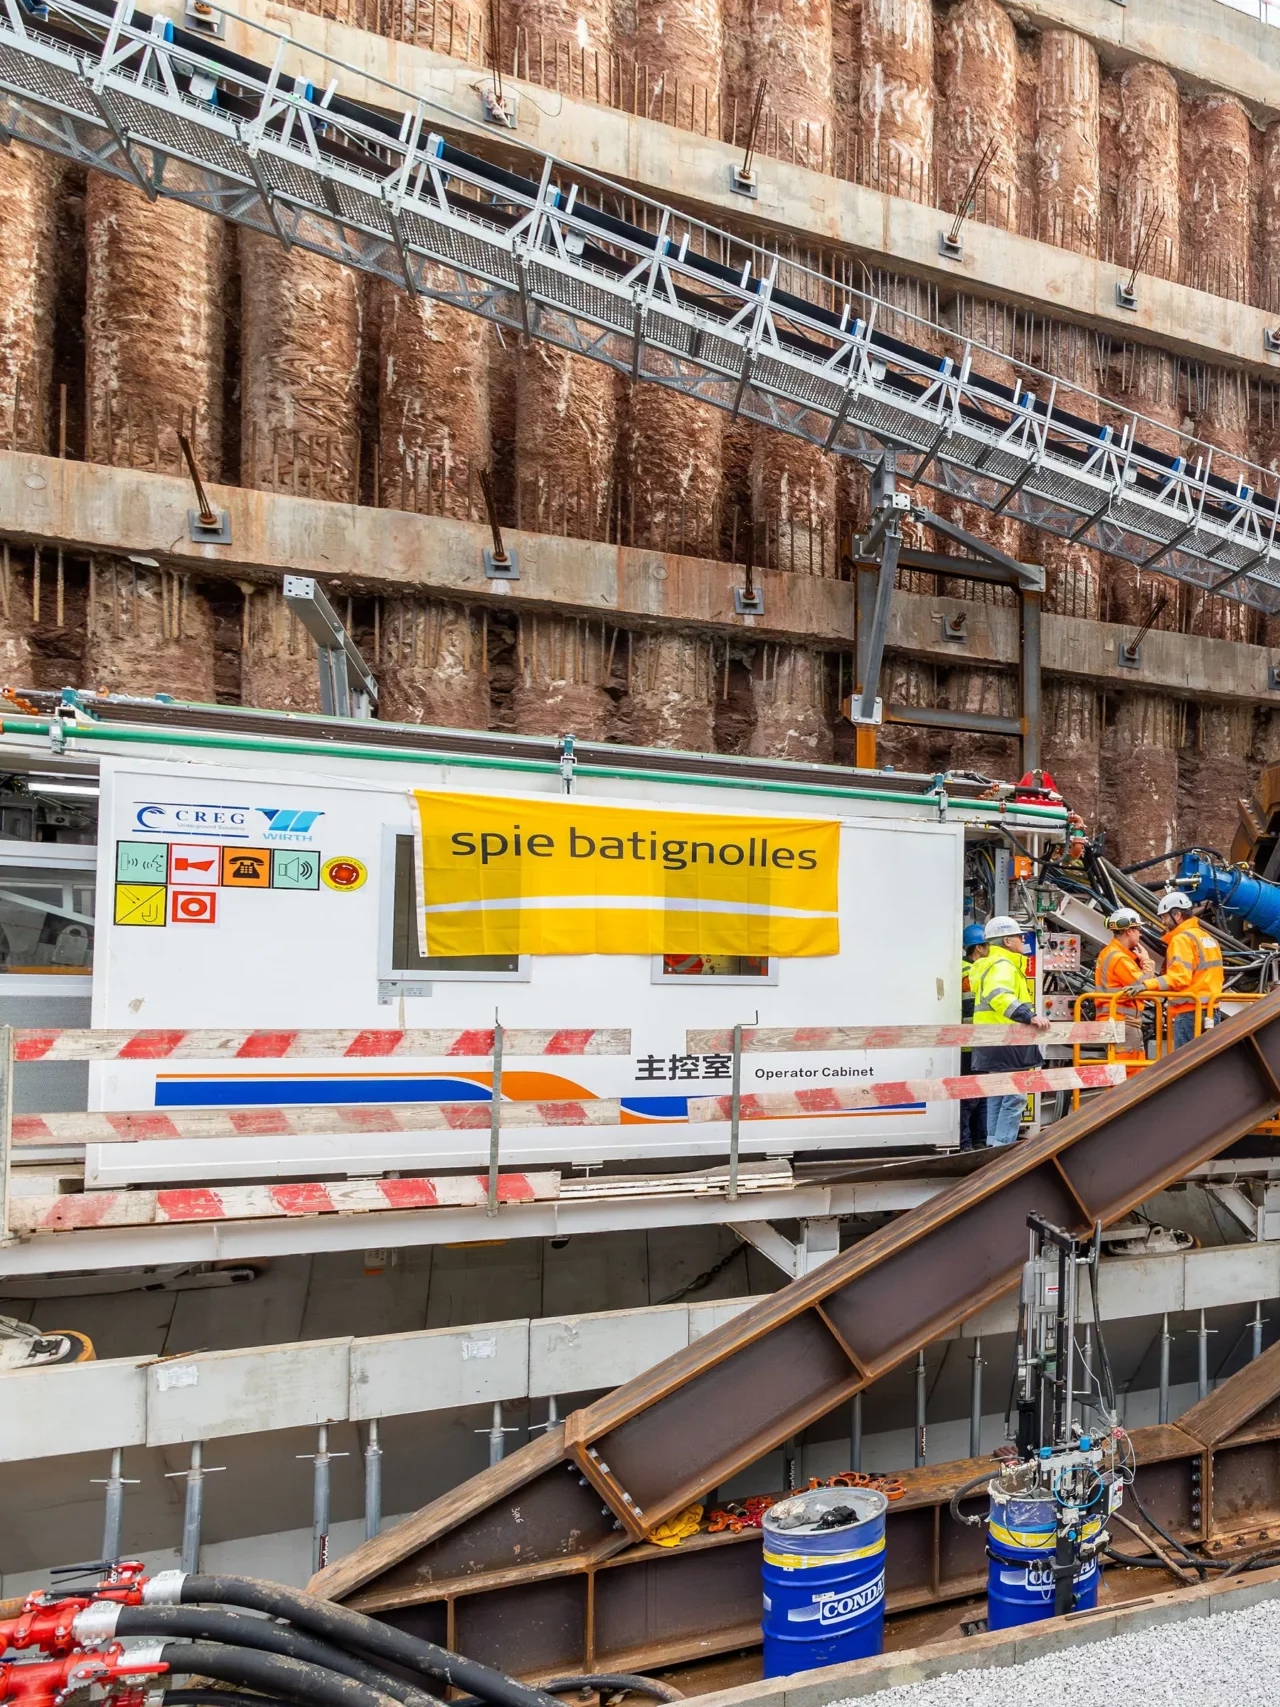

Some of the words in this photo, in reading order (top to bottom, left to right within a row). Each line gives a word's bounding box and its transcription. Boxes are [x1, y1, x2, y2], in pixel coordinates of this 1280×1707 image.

[175, 809, 245, 825] CREG
[177, 822, 217, 830] Underground
[262, 832, 313, 842] WIRTH
[451, 823, 555, 865] spie
[569, 826, 818, 871] batignolles
[635, 1053, 733, 1082] 主控室
[754, 1066, 819, 1081] Operator
[821, 1065, 875, 1078] Cabinet
